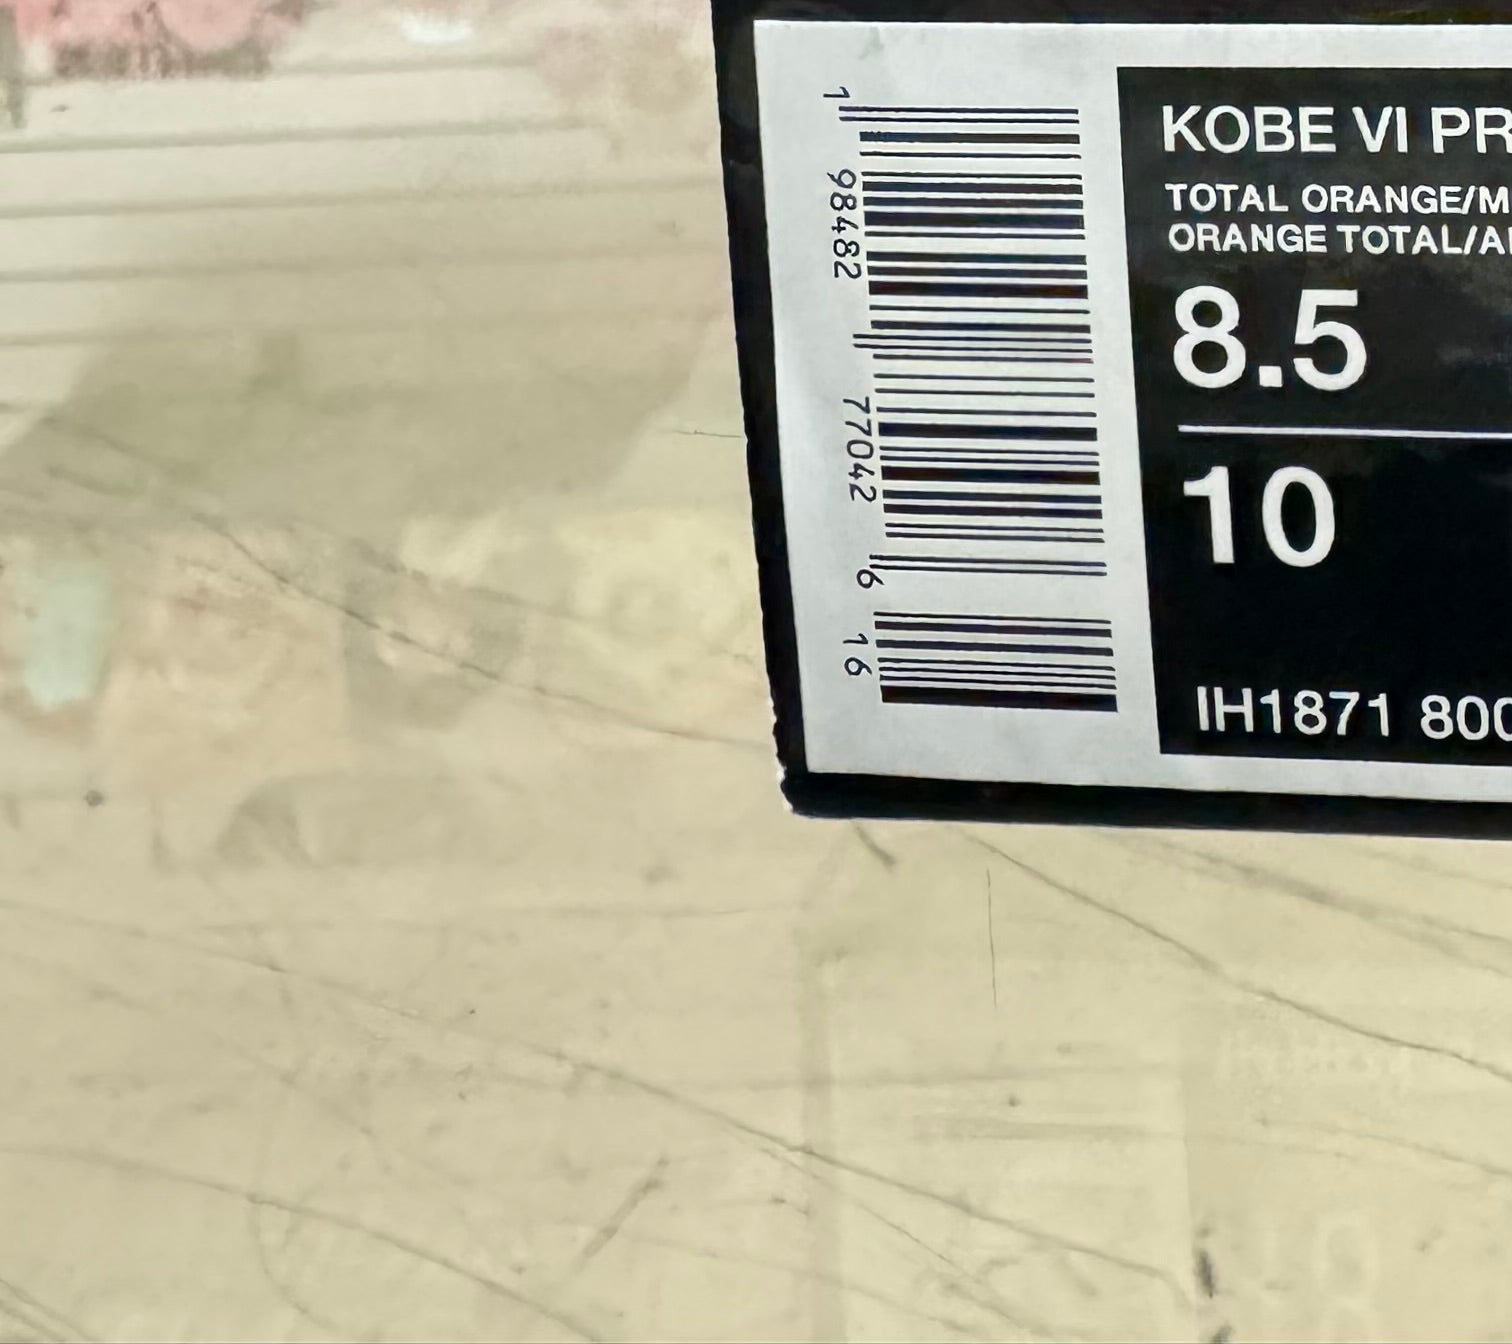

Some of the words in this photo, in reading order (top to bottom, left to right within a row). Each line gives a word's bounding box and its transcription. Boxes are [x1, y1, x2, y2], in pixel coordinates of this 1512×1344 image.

[822, 86, 851, 99] 1
[1162, 105, 1337, 154] KOBE
[1351, 105, 1408, 153] VI
[1164, 182, 1289, 213] TOTAL
[826, 168, 862, 280] 98482
[1168, 222, 1328, 254] ORANGE
[1173, 285, 1367, 391] 8.5
[842, 396, 877, 503] 77042
[1183, 465, 1336, 568] 10
[856, 568, 885, 590] 6
[842, 632, 873, 677] 16
[1197, 686, 1389, 737] IH1871
